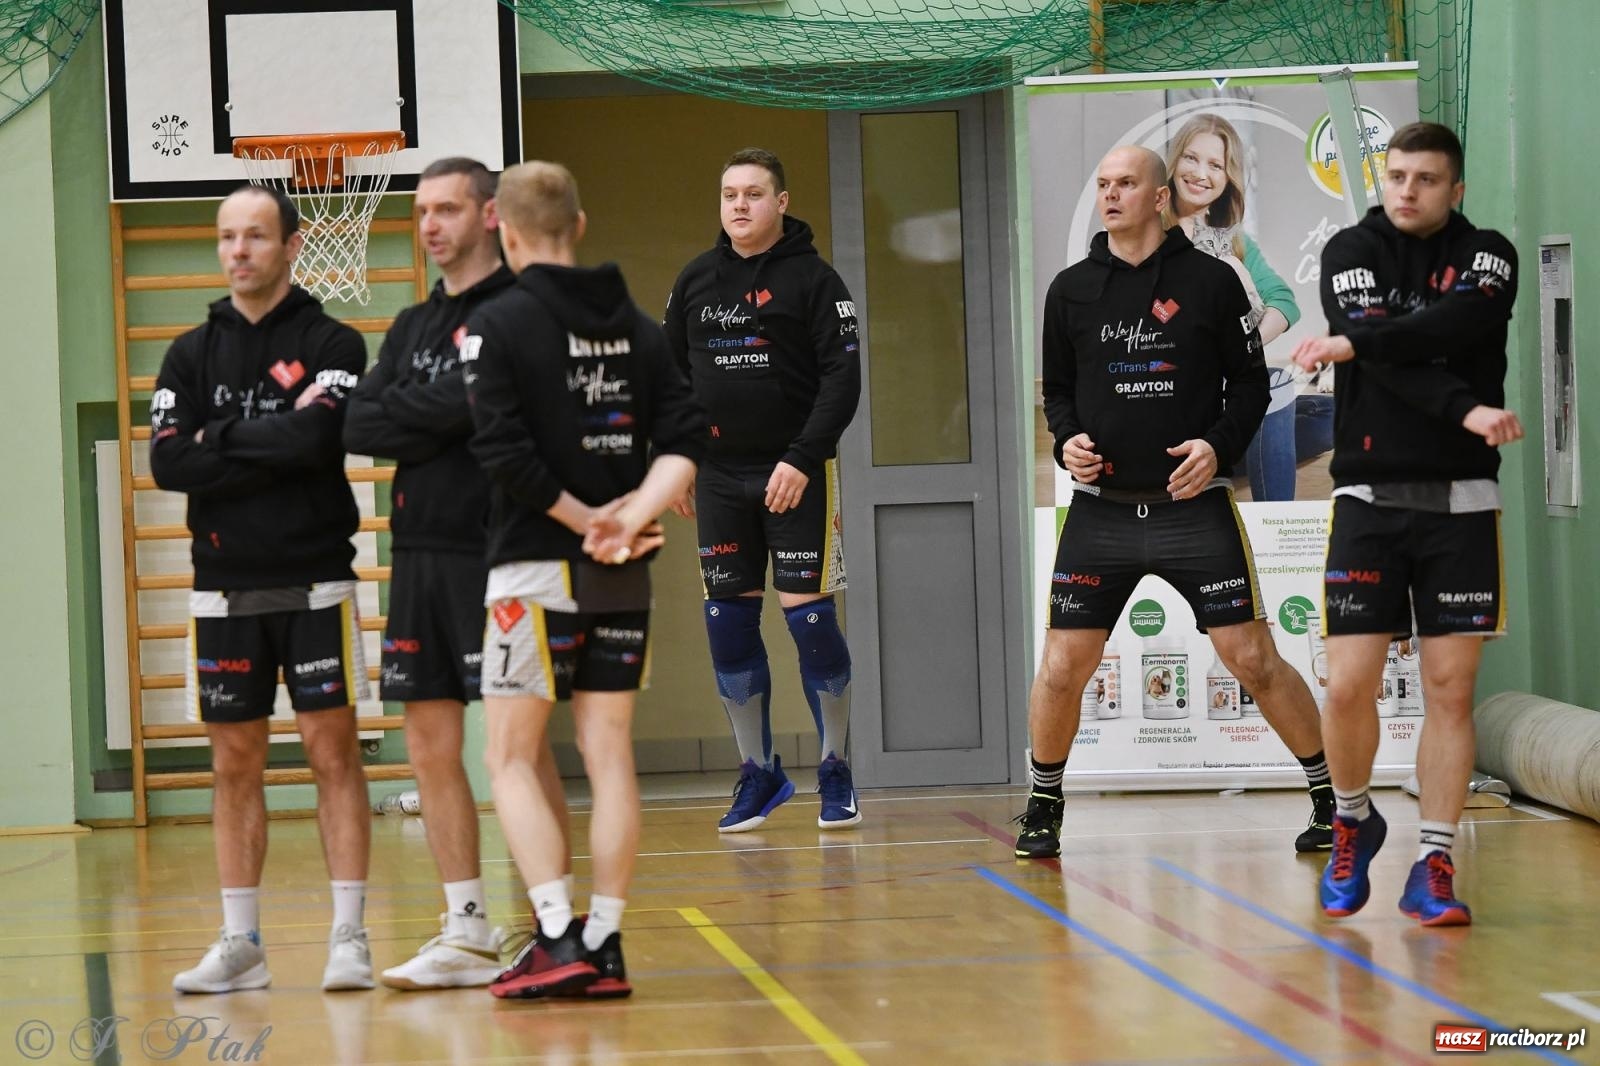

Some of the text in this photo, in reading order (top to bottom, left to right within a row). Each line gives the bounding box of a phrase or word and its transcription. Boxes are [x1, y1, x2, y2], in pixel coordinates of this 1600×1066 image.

[151, 114, 189, 130] SURE
[152, 140, 189, 157] SHOT
[1295, 254, 1321, 285] Ce
[1472, 251, 1512, 281] ENTER
[1332, 267, 1376, 295] ENTER
[720, 304, 751, 331] Hair
[1123, 318, 1163, 354] Hair
[714, 353, 769, 366] GRAVTON
[1115, 380, 1174, 394] GRAVTON
[1278, 527, 1314, 537] Agnieszka
[776, 551, 818, 560] GRAVTON
[1200, 577, 1246, 595] GRAVTON
[1437, 592, 1493, 603] GRAVTON
[498, 644, 511, 678] 7
[1139, 727, 1191, 735] REGENERACJA
[1387, 723, 1415, 731] CZYSTE
[1138, 736, 1171, 744] ZDROWIE
[1173, 733, 1198, 744] SKÓRY
[1230, 734, 1260, 742] SIERŚCI
[1392, 732, 1412, 740] USZY
